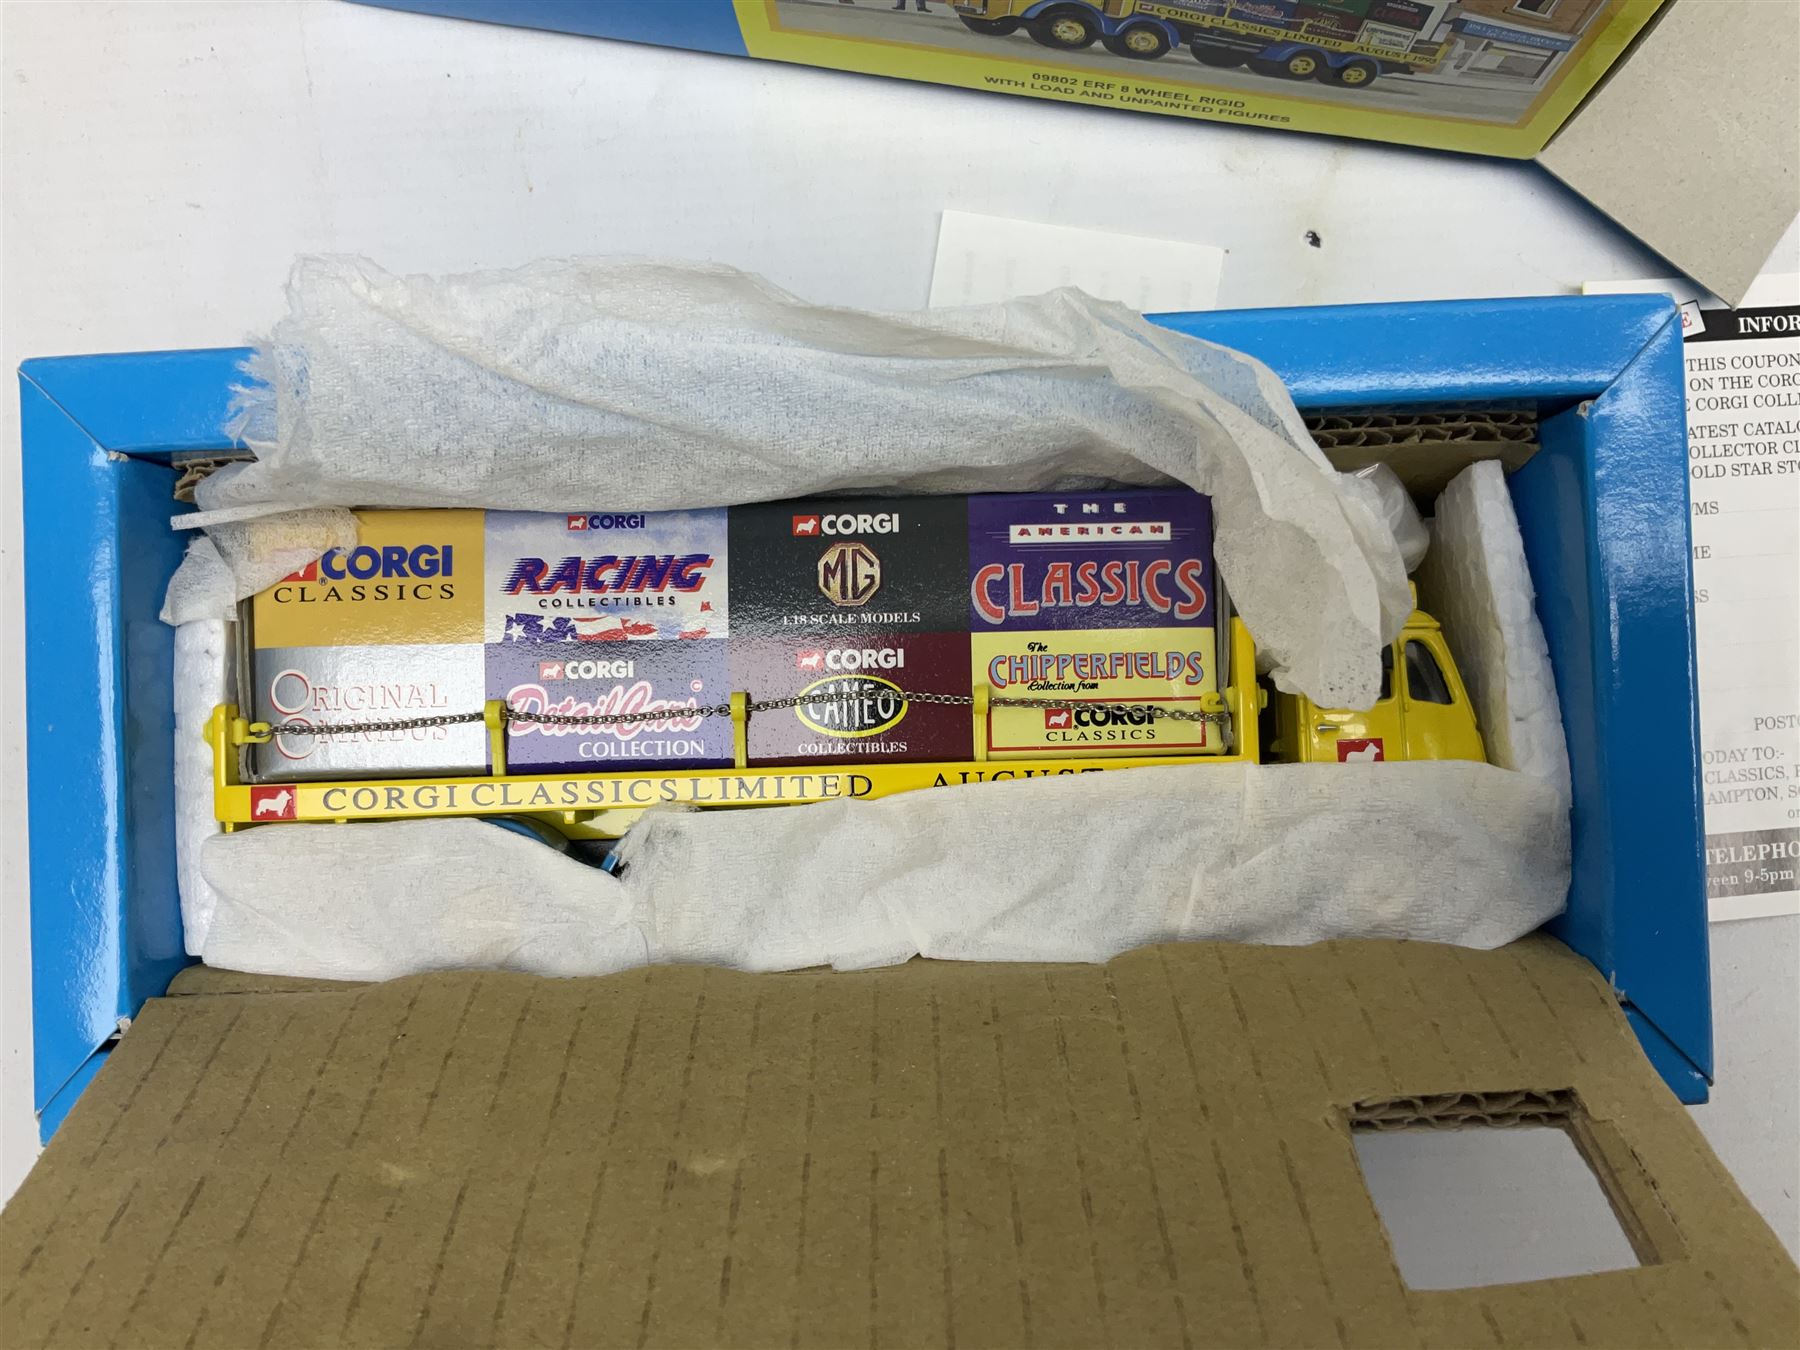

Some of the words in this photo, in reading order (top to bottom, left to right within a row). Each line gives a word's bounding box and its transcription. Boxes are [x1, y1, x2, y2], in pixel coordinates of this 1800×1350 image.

[1156, 7, 1208, 22] CORGI
[1210, 18, 1281, 36] CLASSICS
[984, 76, 1025, 88] WITH
[1030, 83, 1075, 95] LOAD
[1079, 90, 1114, 100] AND
[1119, 95, 1213, 113] UNPAINTED
[1218, 108, 1291, 123] FIGURES
[1032, 72, 1078, 86] 09802
[1083, 80, 1116, 90] ERF
[1135, 87, 1194, 102] WHEEL
[1199, 96, 1246, 108] RIGID
[1686, 357, 1727, 371] THIS
[1689, 377, 1714, 392] ON
[1718, 375, 1753, 390] THE
[1695, 395, 1748, 411] CORGI
[1689, 441, 1778, 459] OLLECTOR
[1731, 461, 1773, 477] STAR
[1777, 460, 1800, 474] ST
[1053, 502, 1127, 514] THE
[588, 515, 645, 529] CORGI
[821, 513, 899, 535] CORGI
[1018, 525, 1164, 537] AMERICAN
[321, 544, 453, 580] CORGI
[499, 554, 714, 595] RACING
[822, 548, 876, 601] MG
[274, 583, 454, 603] CLASSICS
[971, 559, 1206, 625] CLASSICS
[538, 596, 676, 608] COLLECTIBLES
[811, 613, 857, 625] SCALE
[860, 612, 921, 624] MODELS
[1027, 642, 1048, 653] The
[825, 649, 905, 670] CORGI
[565, 660, 634, 680] CORGI
[988, 651, 1204, 689] CHIPPERFIELDS
[270, 668, 448, 716] ORIGINAL
[1027, 680, 1075, 692] Collection
[1075, 680, 1099, 693] from
[807, 681, 896, 728] CAMEO
[1074, 704, 1155, 727] CORGI
[1754, 714, 1800, 731] POST
[1046, 729, 1156, 742] CLASSICS
[579, 740, 704, 758] COLLECTION
[798, 742, 908, 755] COLLECTIBLES
[1704, 765, 1789, 785] CLASSICS,
[322, 785, 458, 811] CORGI
[471, 779, 678, 806] CLASSICS
[690, 774, 873, 799] LIMITED
[1744, 867, 1794, 885] 9-5pm
